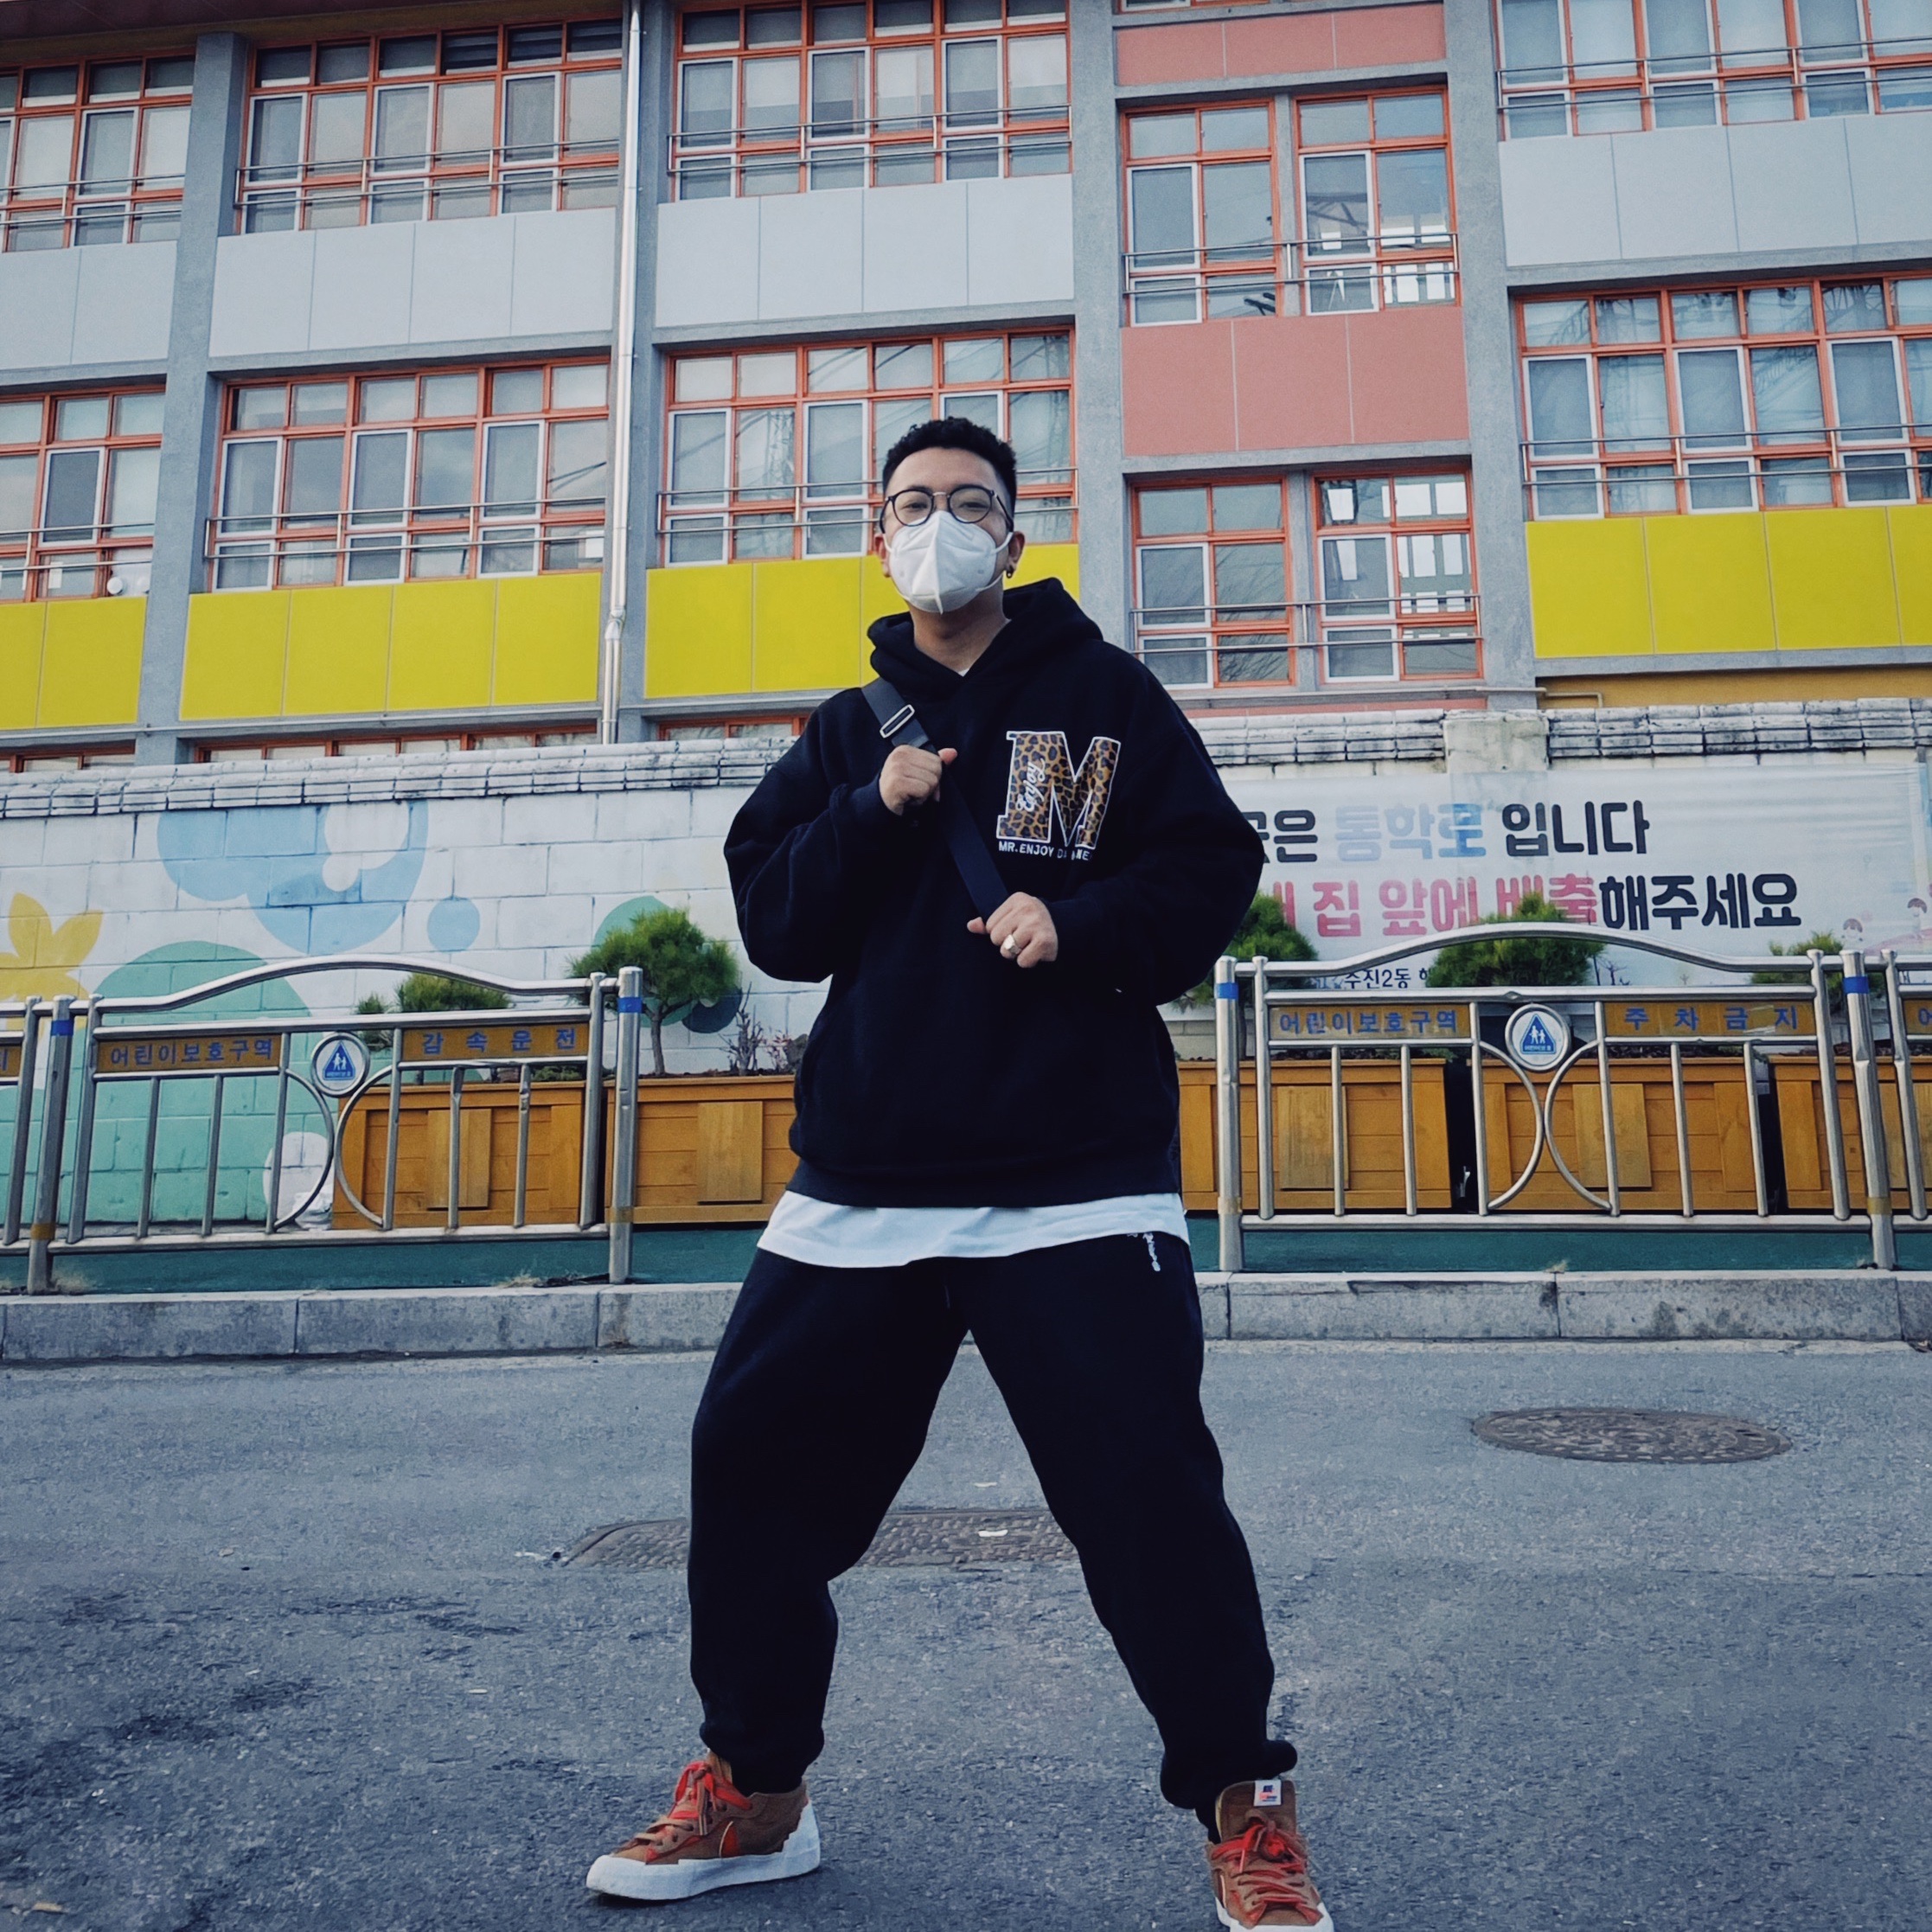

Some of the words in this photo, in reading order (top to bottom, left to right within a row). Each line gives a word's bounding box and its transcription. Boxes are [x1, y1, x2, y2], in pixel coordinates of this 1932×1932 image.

[1015, 758, 1046, 812] Enjoy
[1335, 803, 1487, 862] 통학로
[1502, 801, 1650, 856] 입니다
[1313, 880, 1361, 937] 집
[1379, 876, 1479, 936] 앞에
[1279, 1009, 1456, 1034] 어린이보호구역
[111, 1039, 272, 1067] 어린이보호구역
